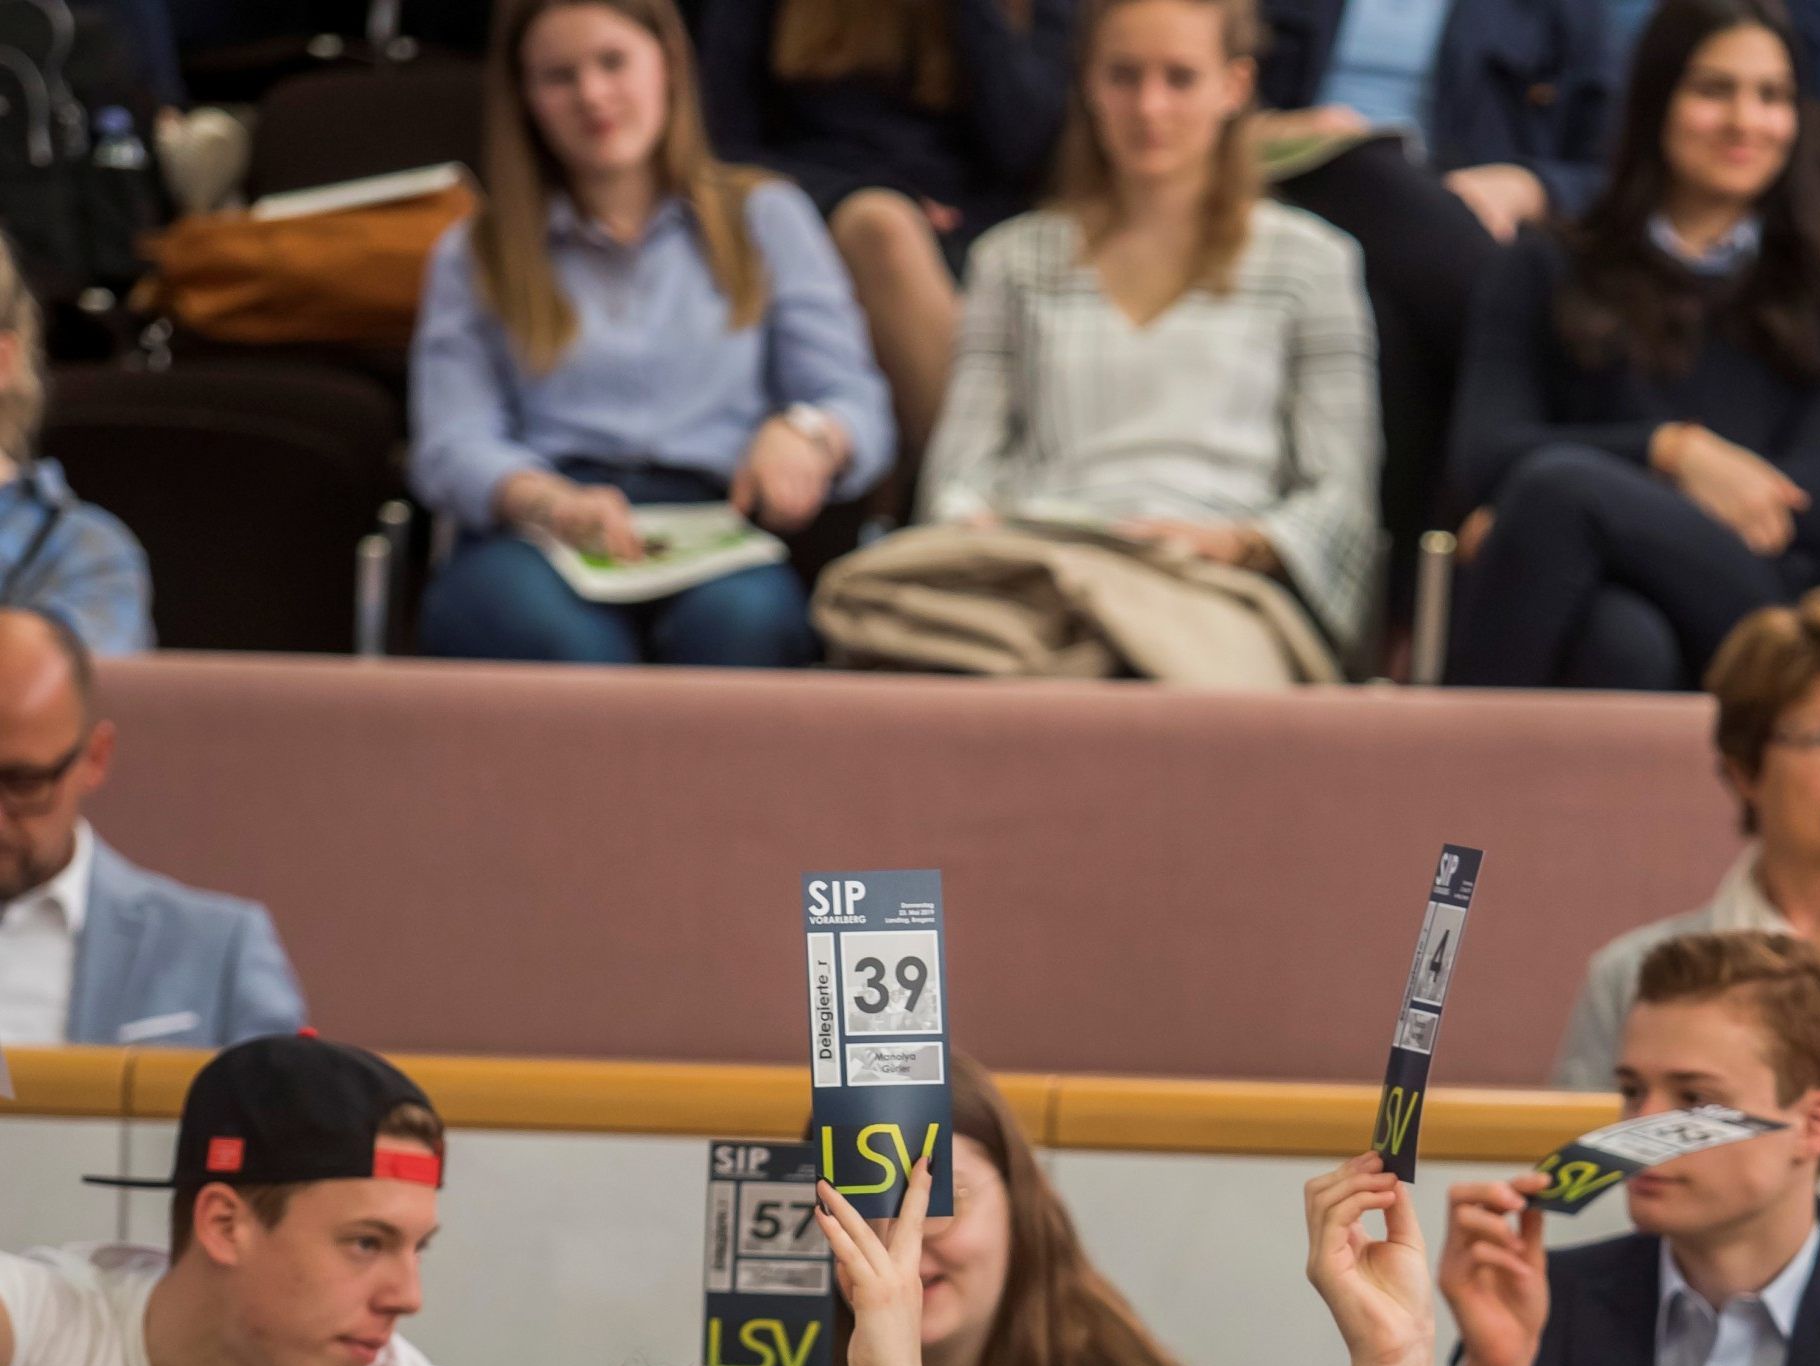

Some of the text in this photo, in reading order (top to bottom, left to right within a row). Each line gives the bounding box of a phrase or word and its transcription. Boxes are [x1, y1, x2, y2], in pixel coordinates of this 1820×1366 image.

[808, 881, 866, 916] SIP
[809, 915, 867, 924] VORARLBERG
[1430, 929, 1450, 982] 4
[854, 956, 928, 1014] 39
[715, 1146, 771, 1174] SIP
[821, 1123, 940, 1195] LSV
[752, 1202, 816, 1239] 57
